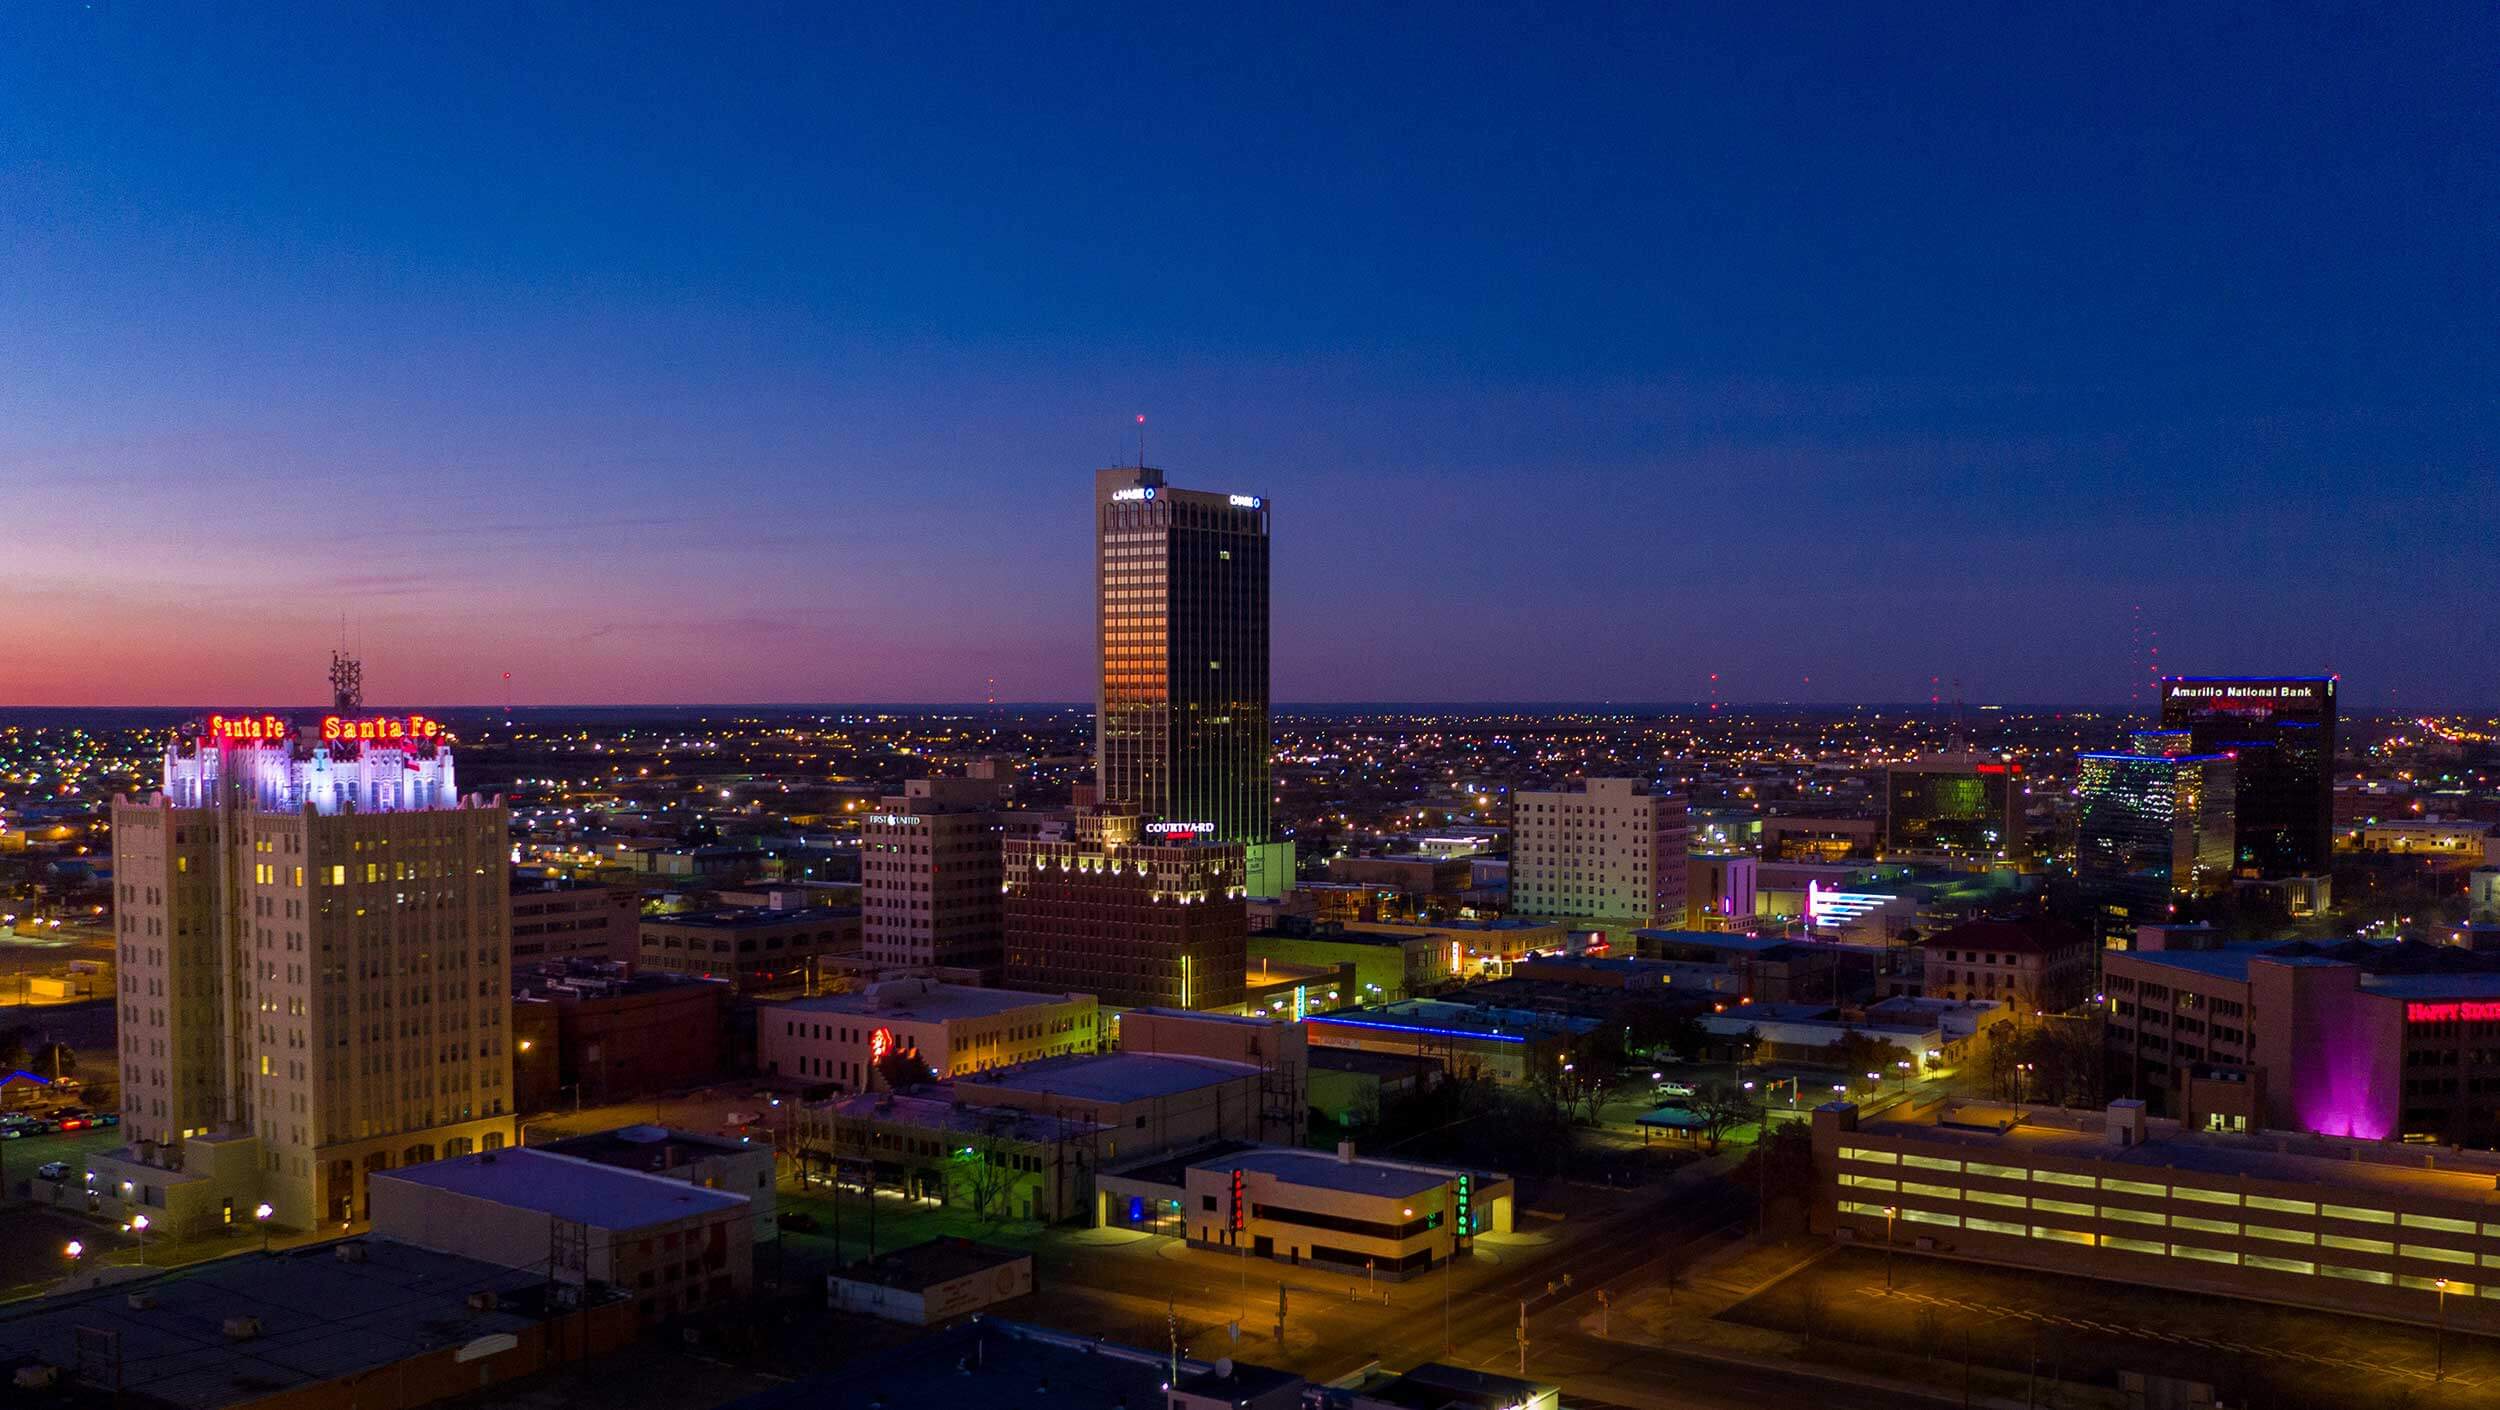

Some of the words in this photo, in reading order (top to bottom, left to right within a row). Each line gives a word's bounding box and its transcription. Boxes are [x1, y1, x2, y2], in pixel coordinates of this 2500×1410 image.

[2171, 686, 2223, 697] Amarillo
[2227, 686, 2277, 697] National
[2280, 686, 2312, 697] Bank
[212, 715, 260, 737] Santa
[265, 716, 285, 737] Fe
[324, 717, 403, 739] Santa
[410, 716, 438, 737] Fe
[869, 815, 888, 824] FIRST
[896, 815, 920, 825] UNITED
[1145, 822, 1215, 833] COURTYARD
[2407, 1003, 2460, 1021] HAPPY
[1458, 1175, 1468, 1236] CANYON
